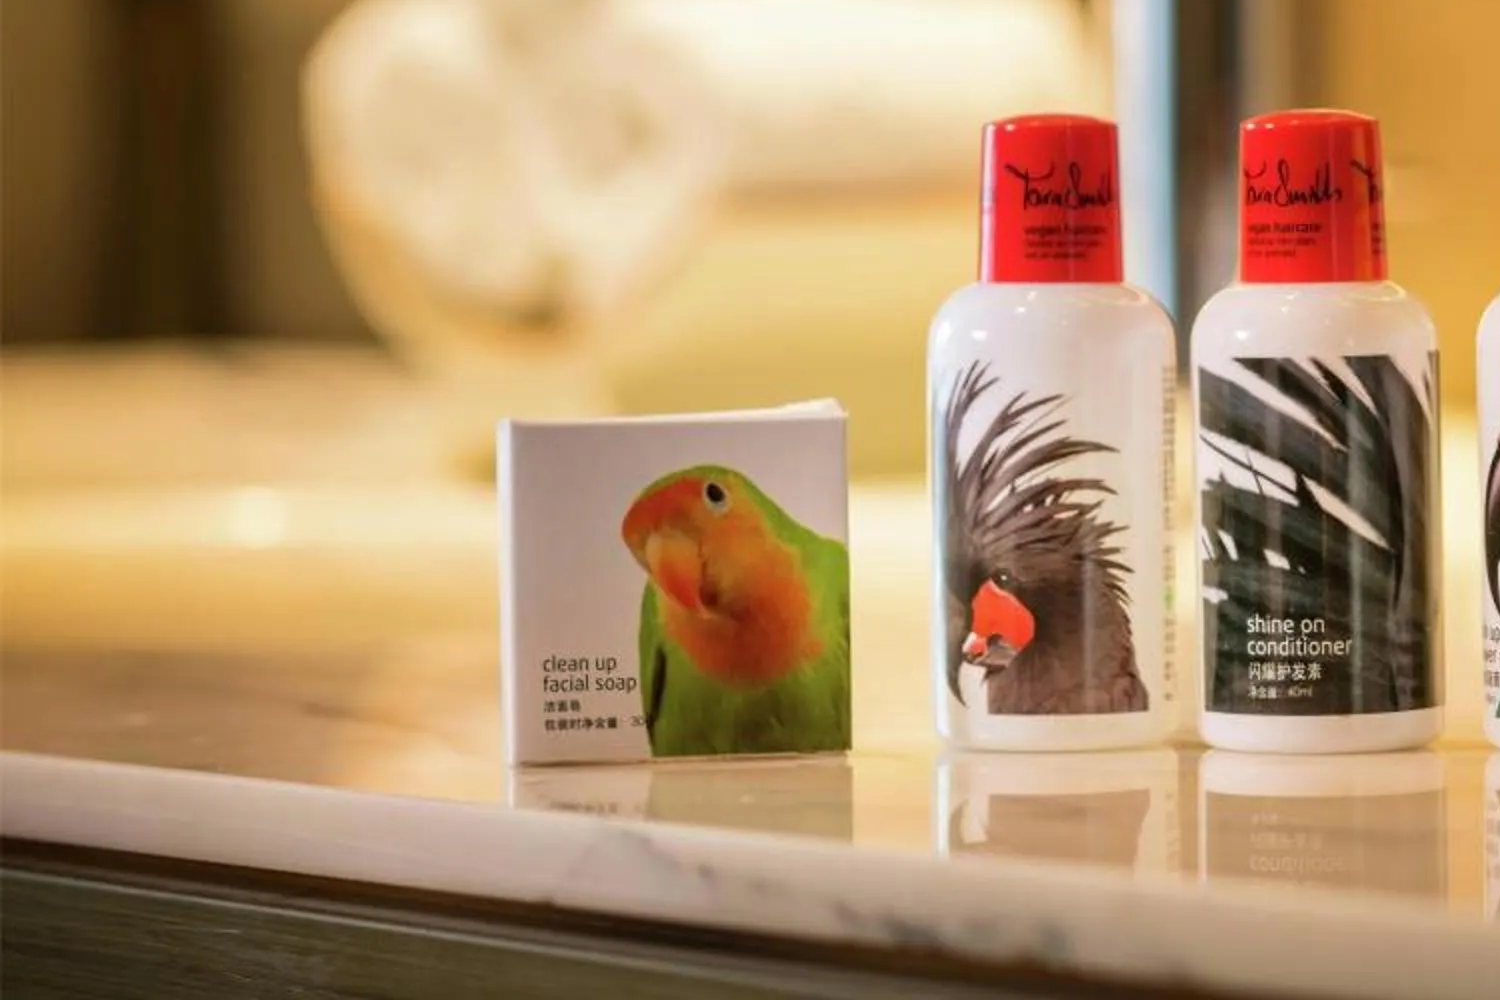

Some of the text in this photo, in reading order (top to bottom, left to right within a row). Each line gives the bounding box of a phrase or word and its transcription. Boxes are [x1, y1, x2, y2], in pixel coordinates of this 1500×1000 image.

[1004, 161, 1062, 210] Tara
[1273, 158, 1343, 207] Smith
[1247, 612, 1326, 634] shine on
[1247, 634, 1353, 656] conditioner
[542, 655, 617, 675] clean up
[543, 674, 637, 694] facial soap
